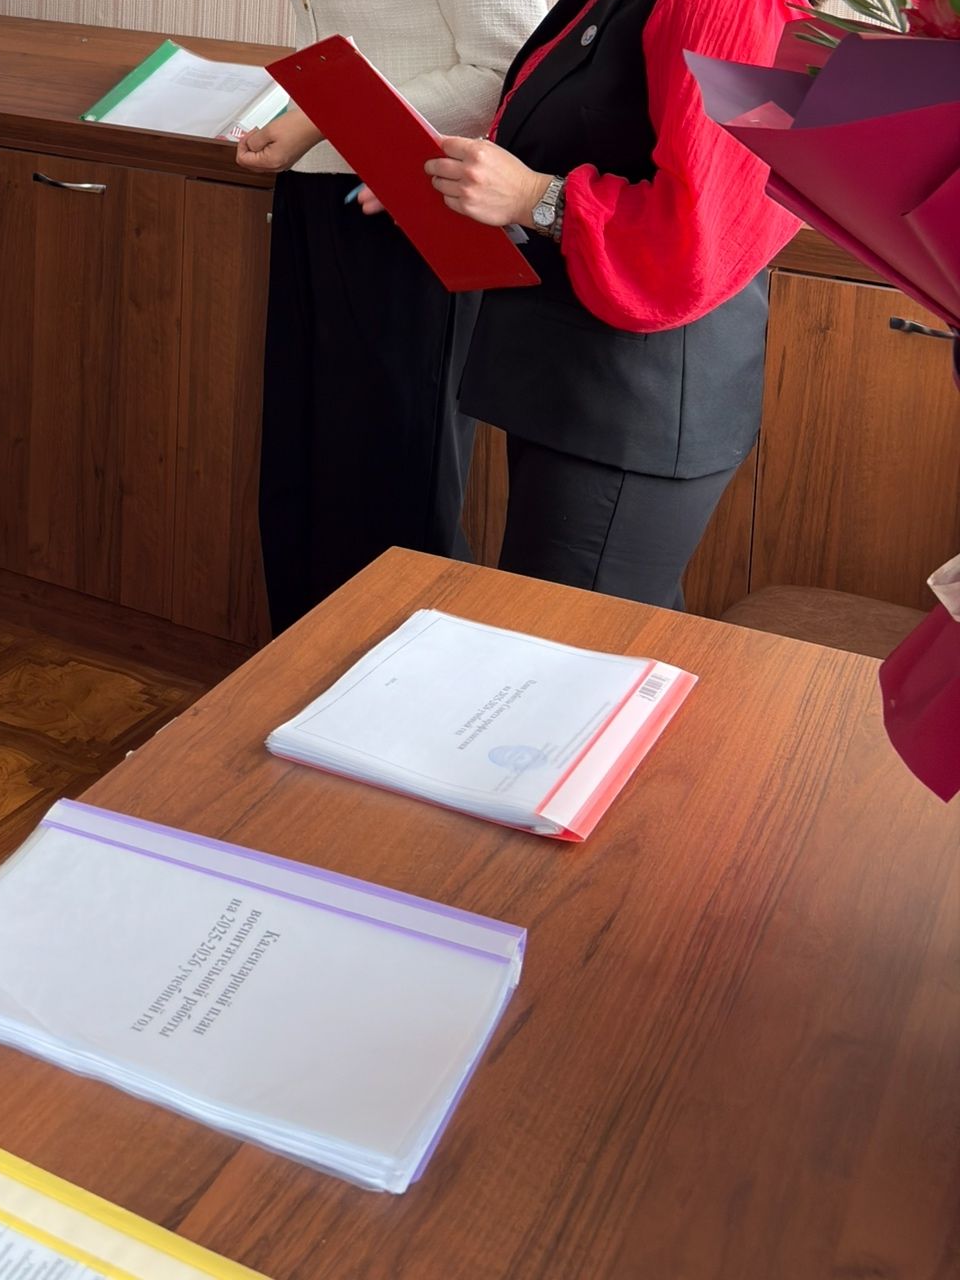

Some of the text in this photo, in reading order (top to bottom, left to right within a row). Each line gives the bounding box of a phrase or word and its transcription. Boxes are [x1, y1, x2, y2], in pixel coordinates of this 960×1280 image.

[226, 898, 242, 913] на
[188, 914, 236, 969] 2025-2026
[148, 964, 193, 1014] учебный
[158, 909, 262, 1038] воспитательной работы
[193, 930, 281, 1036] Календарный план
